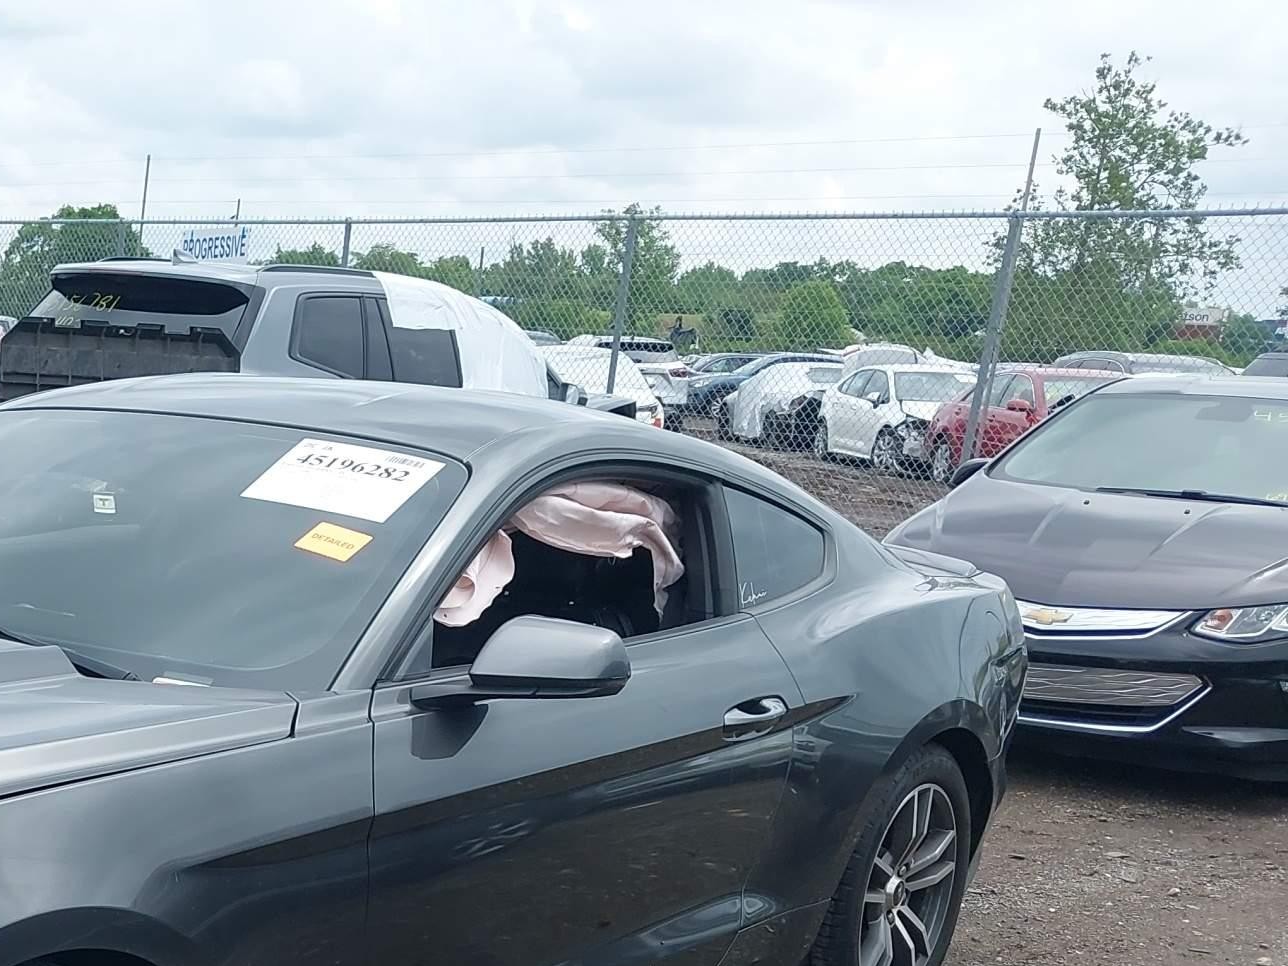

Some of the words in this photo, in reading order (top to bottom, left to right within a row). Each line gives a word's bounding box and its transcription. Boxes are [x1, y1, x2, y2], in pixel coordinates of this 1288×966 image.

[183, 234, 246, 259] PROGRESSIVE
[296, 453, 411, 482] 45196282
[311, 532, 355, 550] DETAILED
